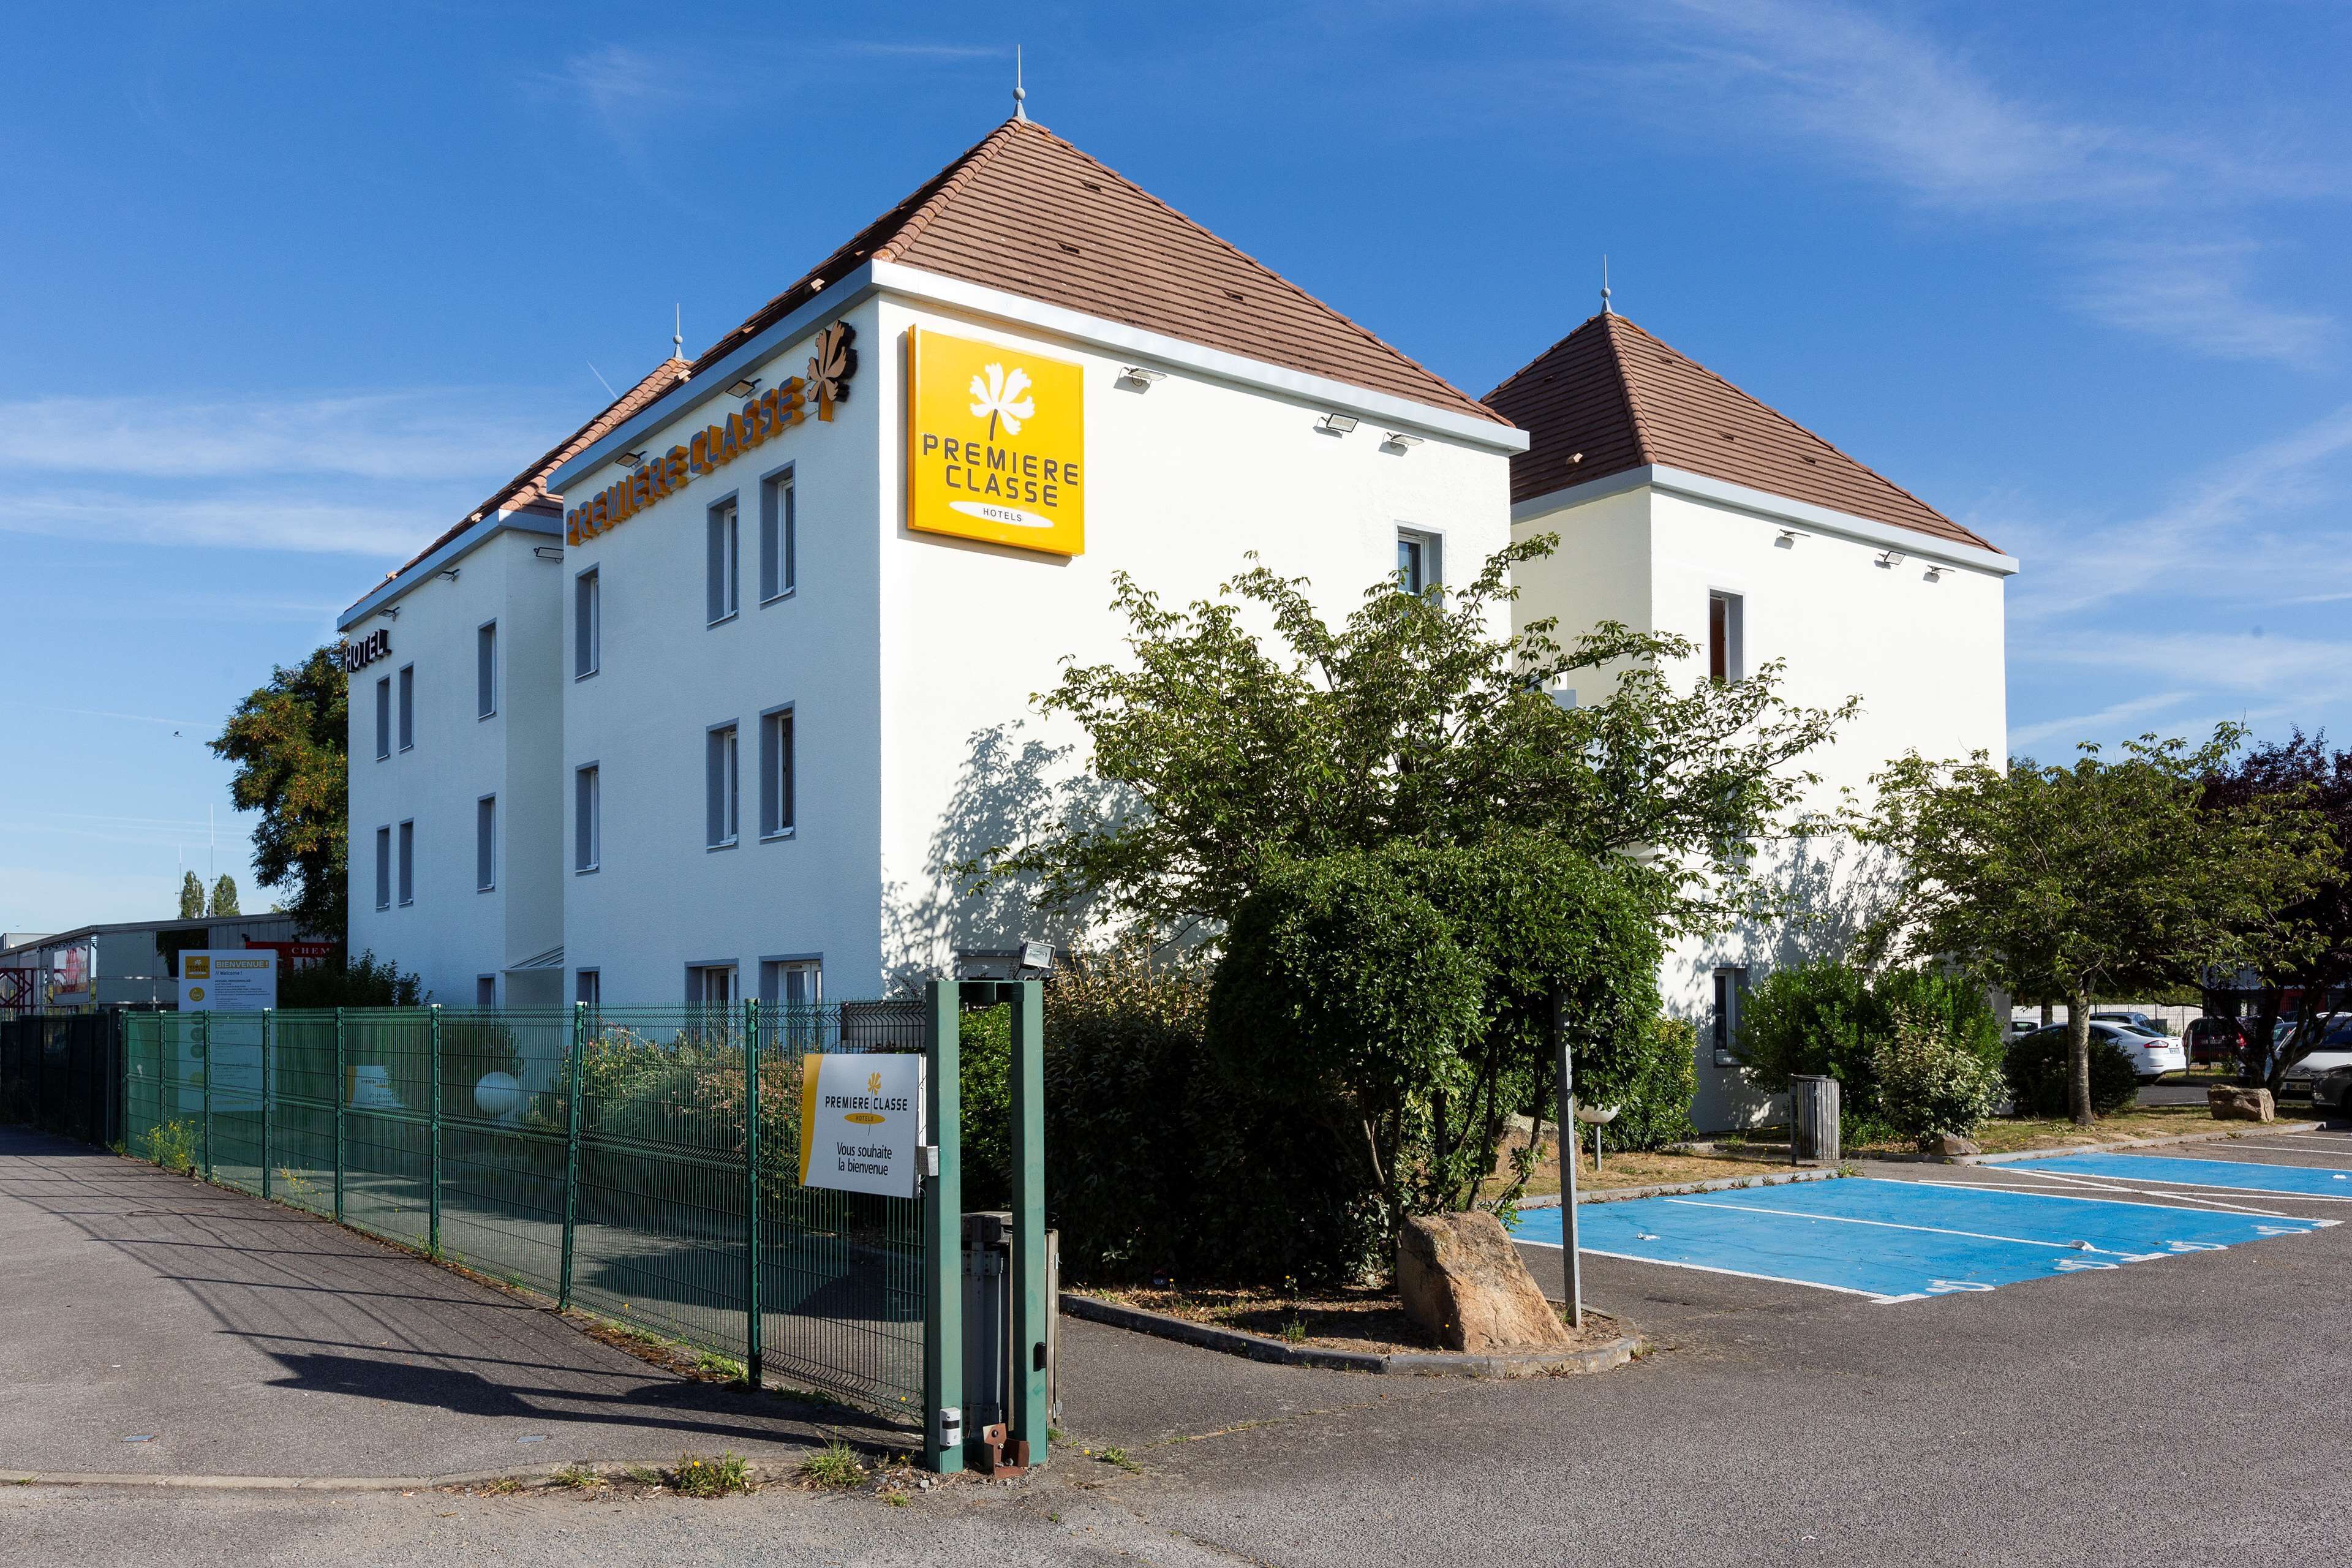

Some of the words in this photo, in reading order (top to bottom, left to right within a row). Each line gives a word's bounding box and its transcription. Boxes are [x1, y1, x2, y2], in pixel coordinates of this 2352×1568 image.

[567, 445, 687, 546] PREMIERE
[690, 375, 804, 475] CLASSE
[922, 432, 1079, 486] PREMIERE
[946, 464, 1058, 507] CLASSE
[982, 507, 1022, 522] HOTELS
[345, 628, 390, 673] HOTEL
[825, 1096, 869, 1109] PREMIERE
[873, 1097, 908, 1111] CLASSE
[837, 1142, 855, 1157] Vous
[858, 1144, 892, 1159] souhaite
[838, 1157, 845, 1172] la
[848, 1158, 888, 1175] bienvenue
